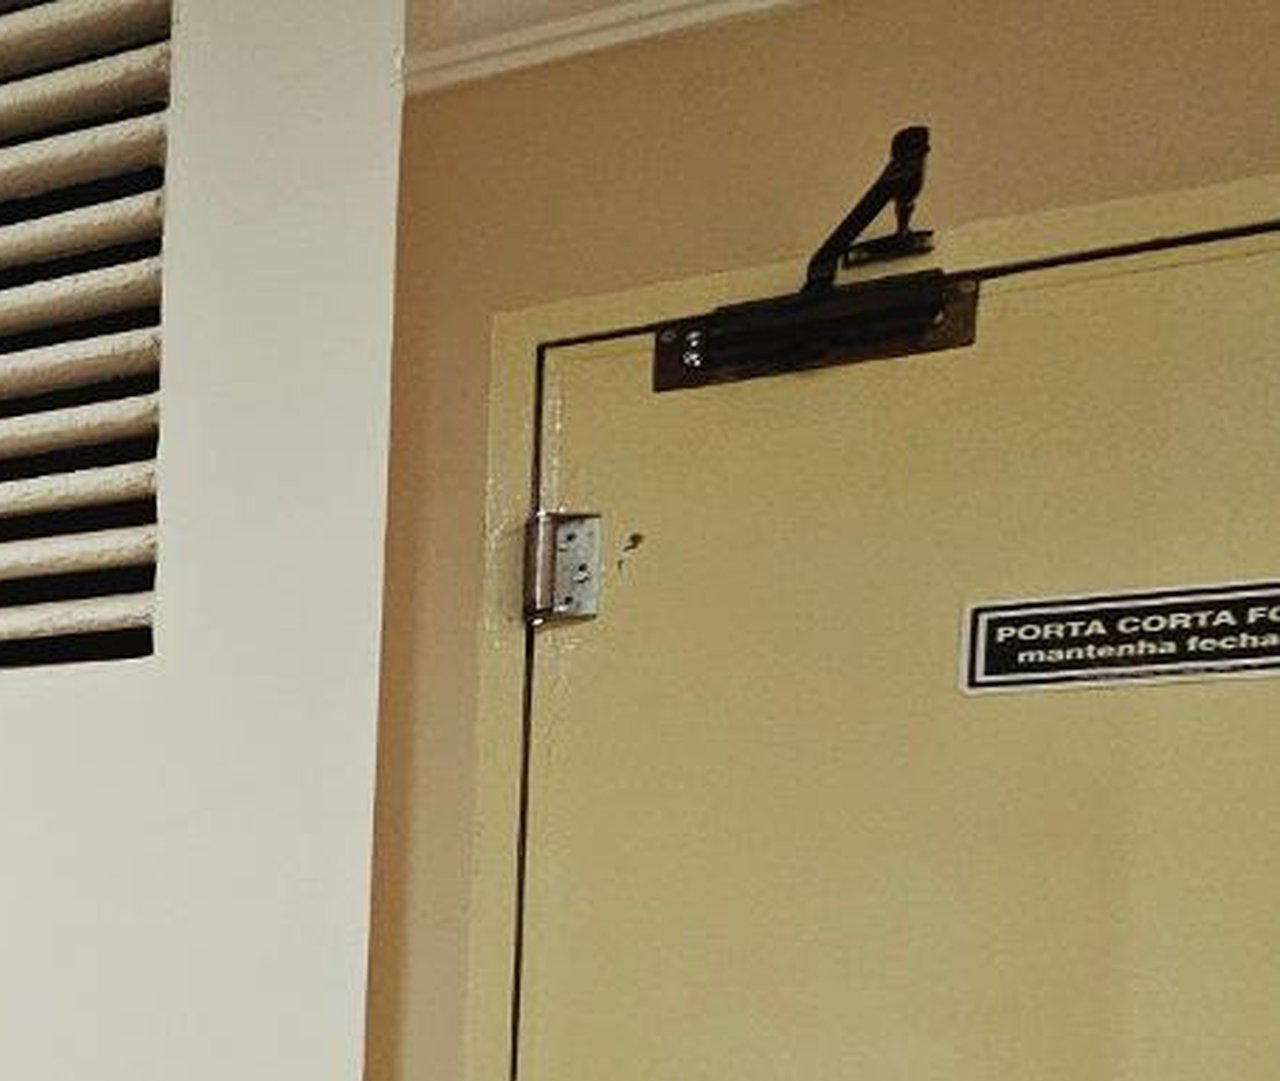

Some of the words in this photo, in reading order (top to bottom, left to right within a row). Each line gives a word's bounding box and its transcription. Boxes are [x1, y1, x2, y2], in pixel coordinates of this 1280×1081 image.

[996, 619, 1108, 643] PORTA
[1117, 609, 1238, 634] CORTA
[1017, 640, 1177, 664] mantenha
